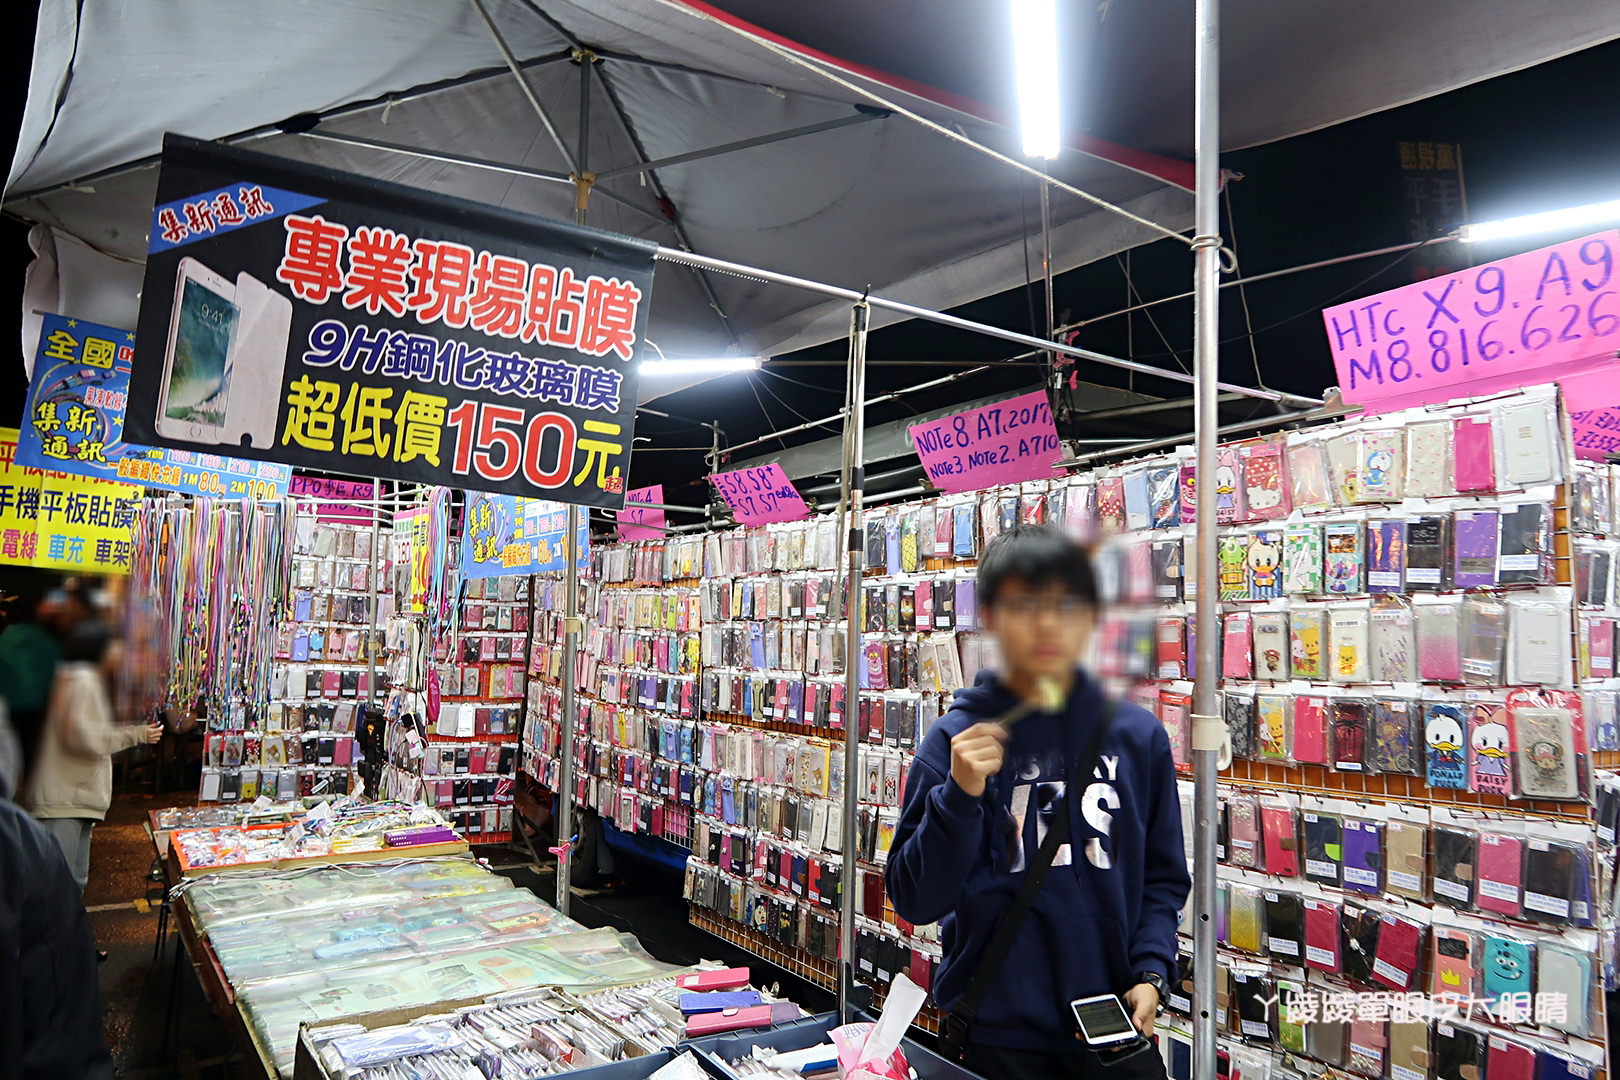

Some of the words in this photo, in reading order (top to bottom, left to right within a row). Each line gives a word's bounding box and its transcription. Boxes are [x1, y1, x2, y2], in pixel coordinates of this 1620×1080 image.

[159, 186, 274, 243] 集新通訊
[276, 214, 641, 360] 專業現場貼膜
[201, 303, 223, 325] 9:41
[302, 319, 623, 413] 9H鋼化玻璃膜
[32, 401, 97, 437] 集新
[42, 435, 107, 463] 通訊
[0, 485, 133, 529] 手機平板貼膜
[47, 533, 86, 563] 車充
[94, 538, 130, 567] 車架
